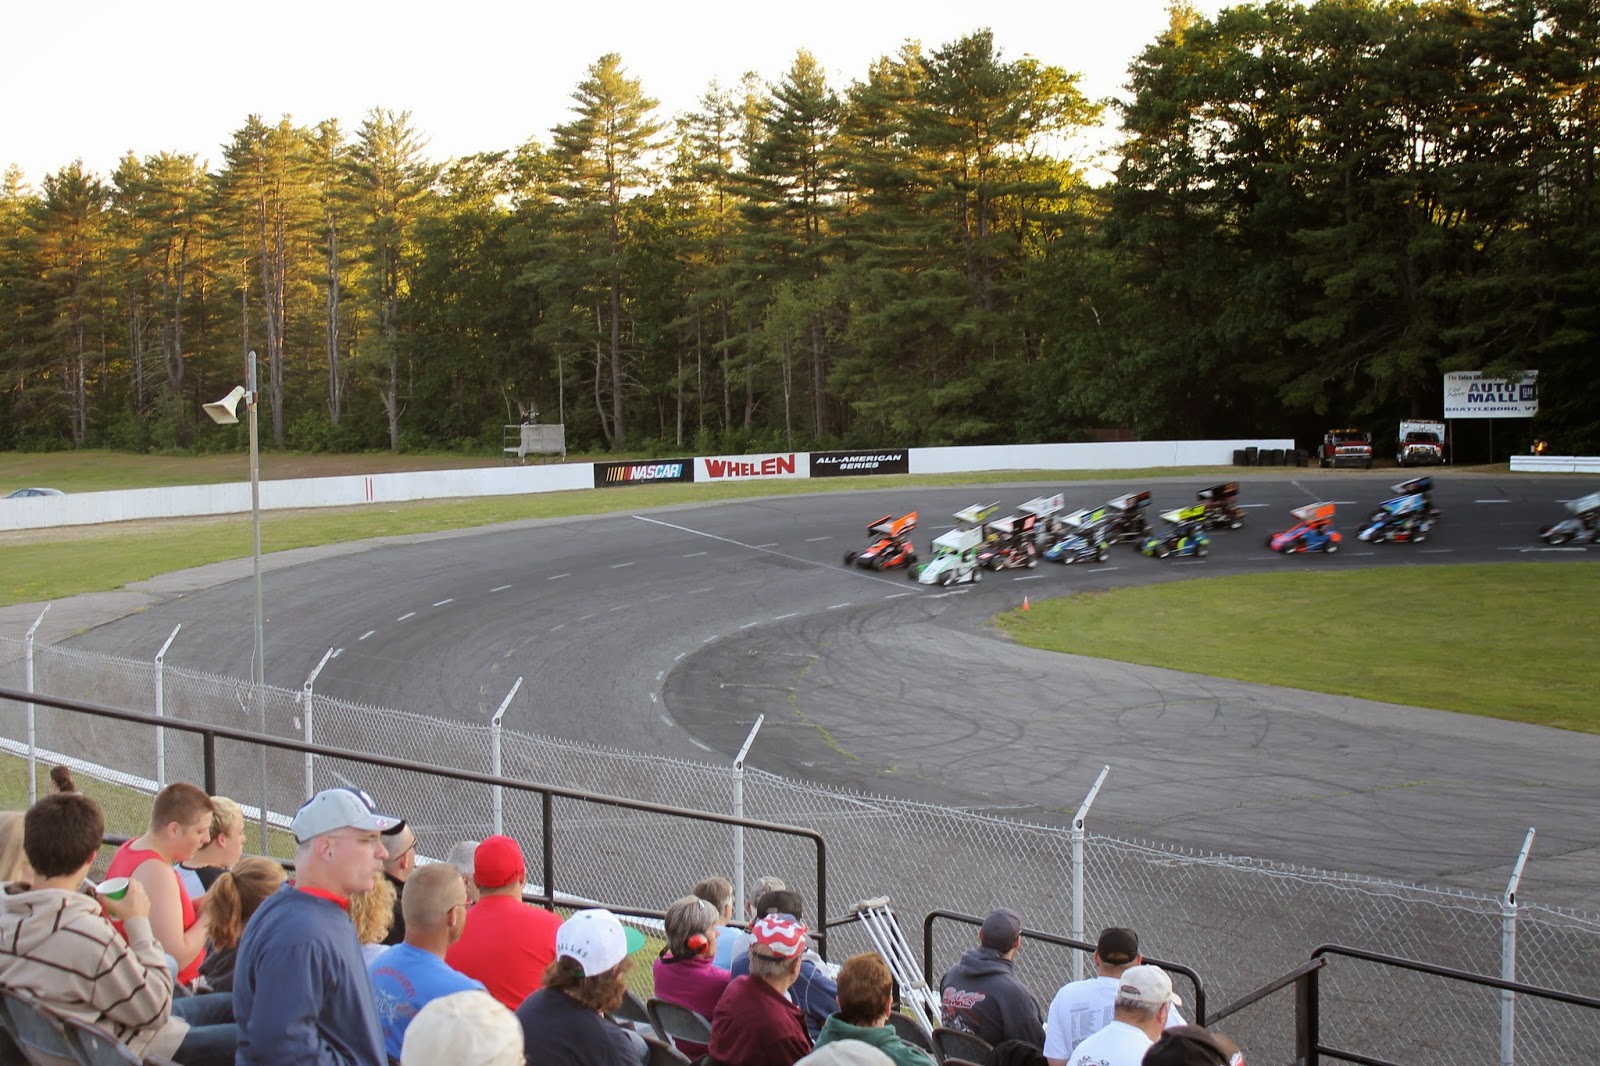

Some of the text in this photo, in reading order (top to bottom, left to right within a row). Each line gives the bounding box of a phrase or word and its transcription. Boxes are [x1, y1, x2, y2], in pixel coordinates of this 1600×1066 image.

[1469, 383, 1516, 392] AUTO
[1467, 393, 1518, 403] MALL
[816, 454, 902, 464] ALL-AMERICAN
[704, 454, 796, 478] WHELEN
[839, 462, 879, 470] SERIES
[629, 463, 682, 480] NASCAR
